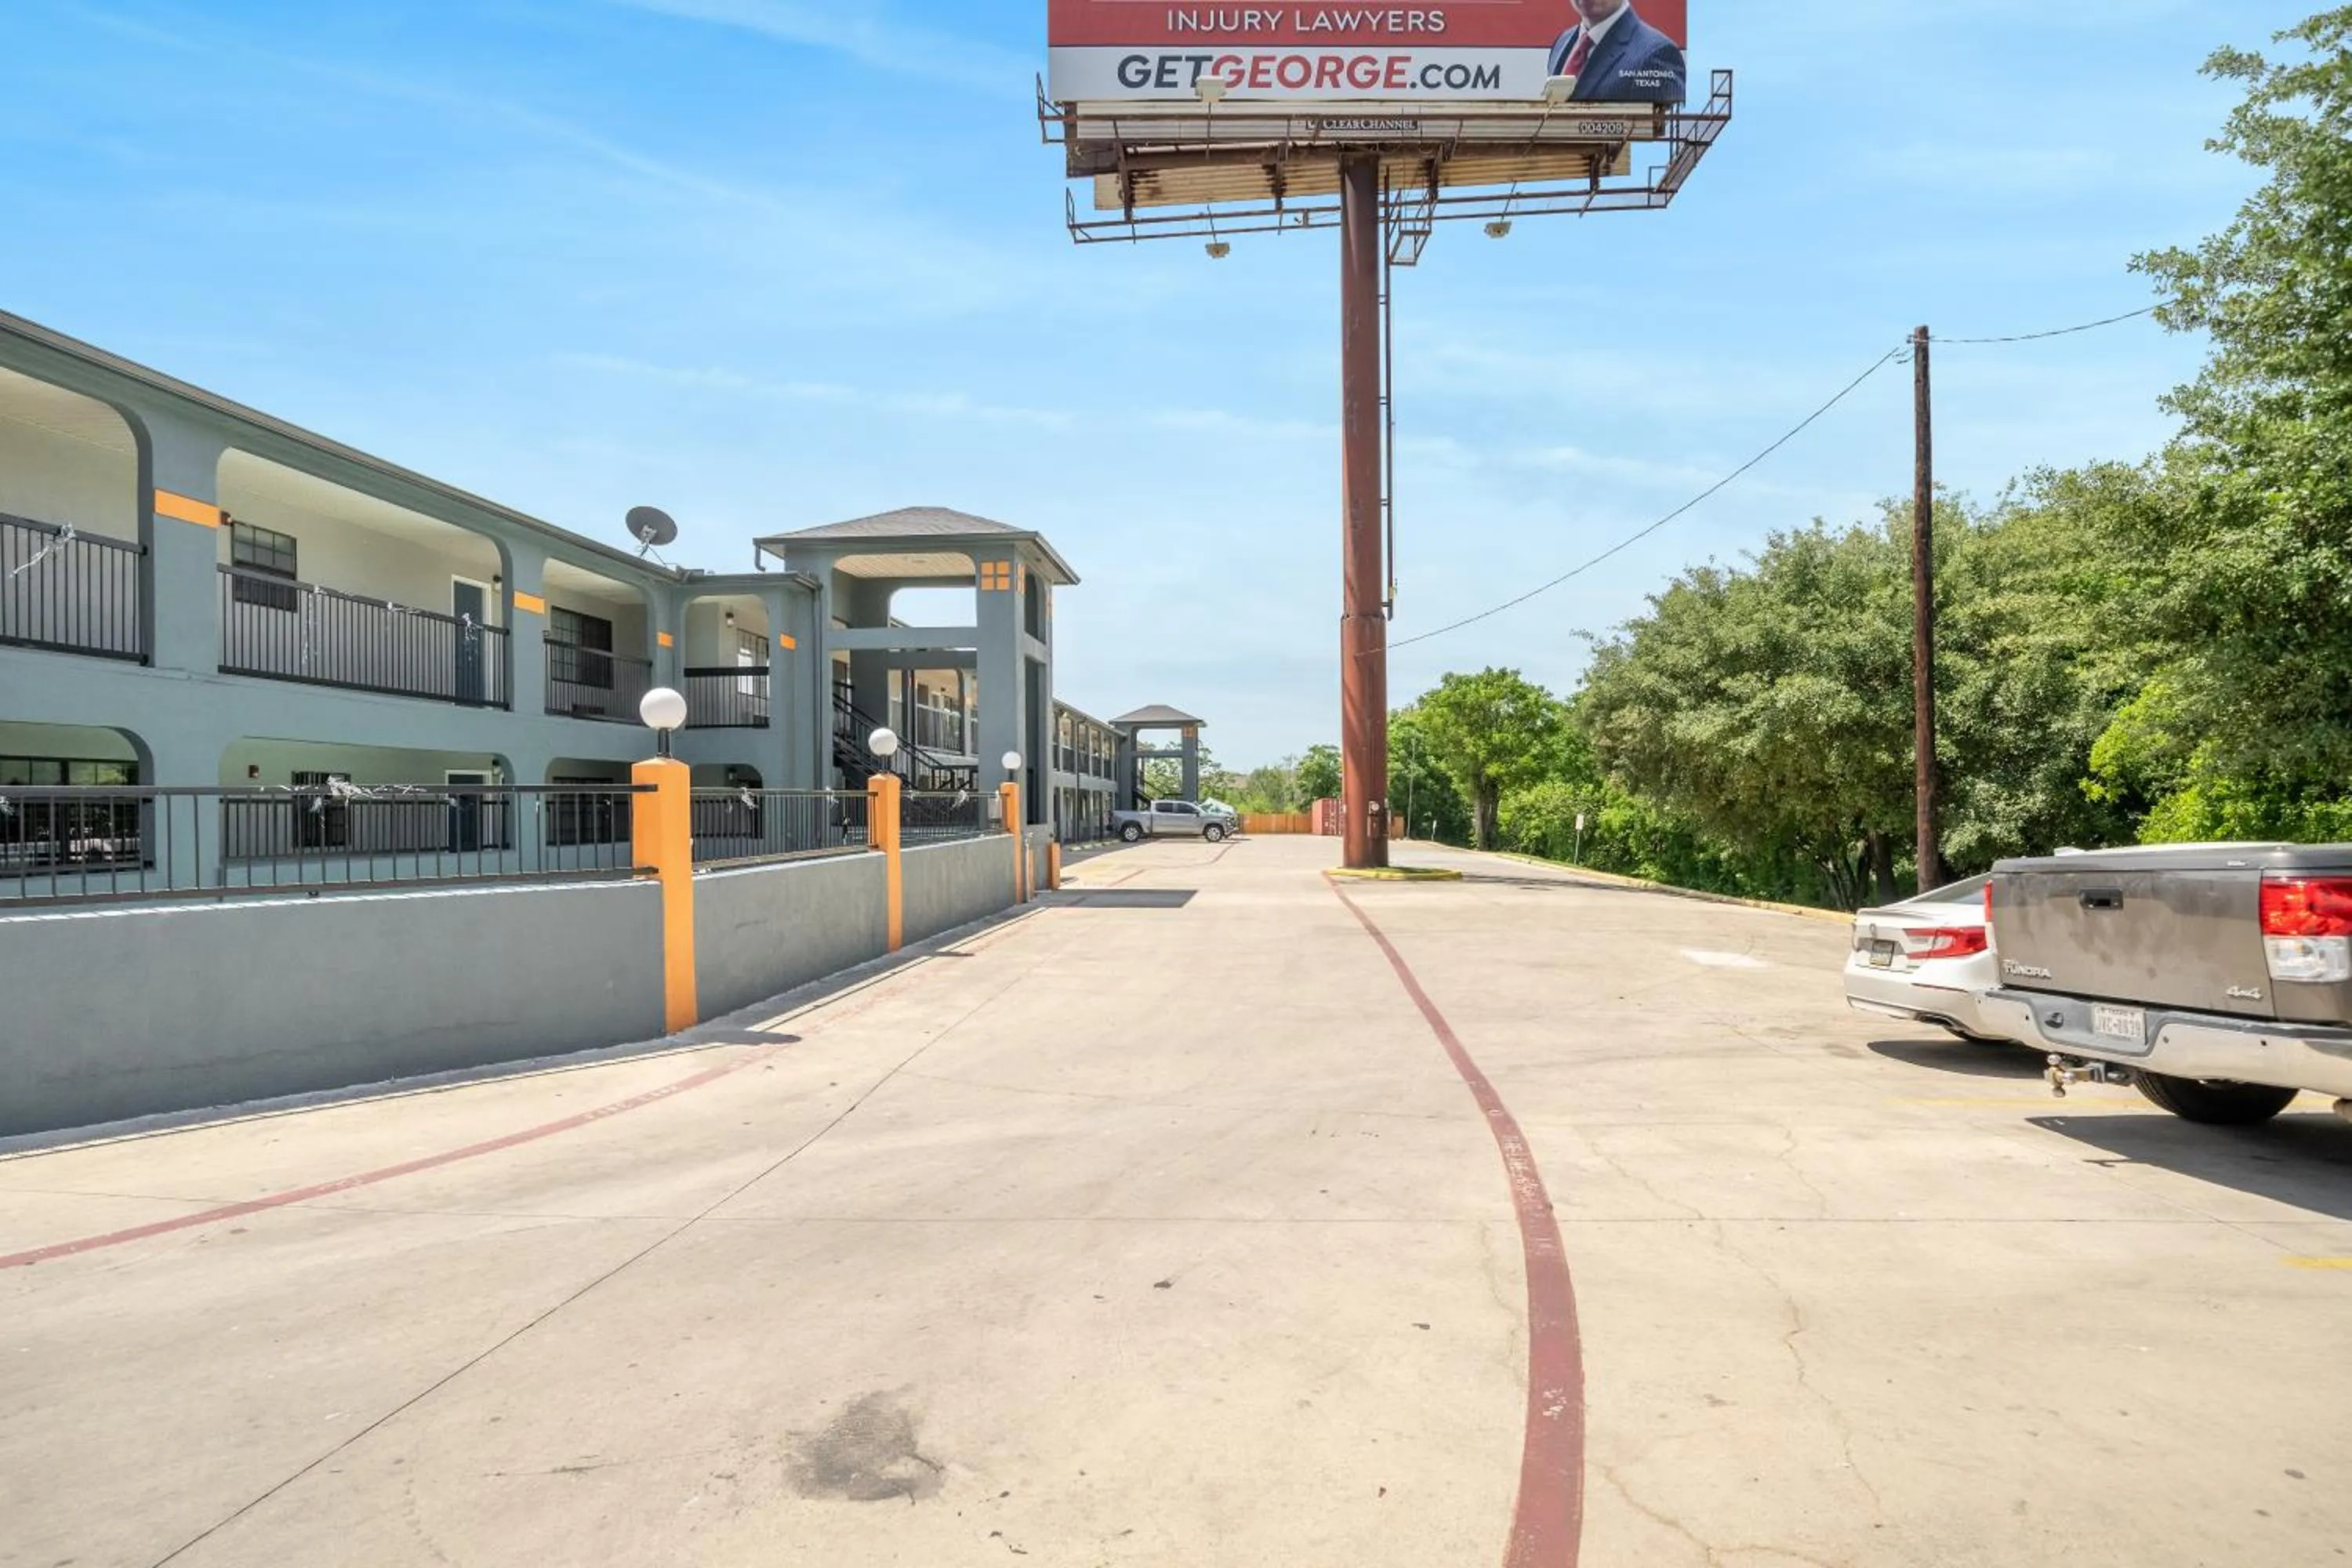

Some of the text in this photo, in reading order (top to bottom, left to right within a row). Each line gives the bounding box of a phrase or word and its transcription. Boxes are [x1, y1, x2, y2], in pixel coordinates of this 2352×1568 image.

[1167, 10, 1446, 32] INJURY LAWYERS
[1117, 54, 1501, 89] GETGEORGE.COM
[1618, 69, 1636, 78] SAN
[2002, 959, 2052, 978] TUNDRA
